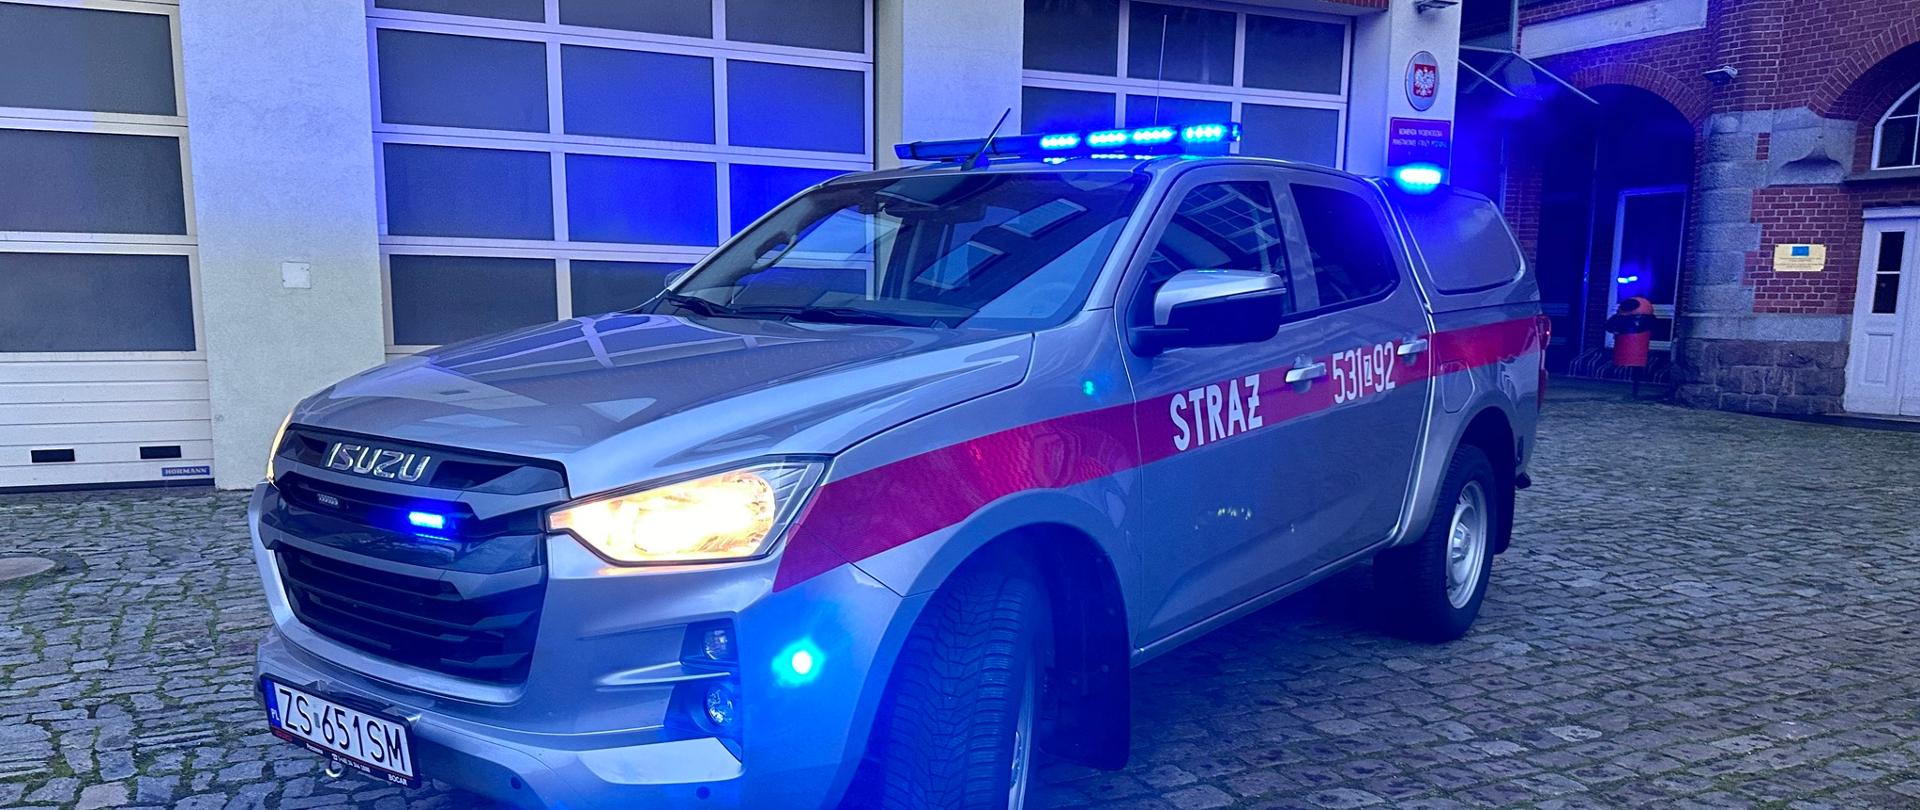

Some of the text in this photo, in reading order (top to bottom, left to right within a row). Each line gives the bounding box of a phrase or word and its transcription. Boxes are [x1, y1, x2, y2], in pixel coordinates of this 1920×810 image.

[326, 442, 431, 482] ISUZU
[270, 707, 280, 721] PL
[279, 688, 406, 772] ZS 651SM
